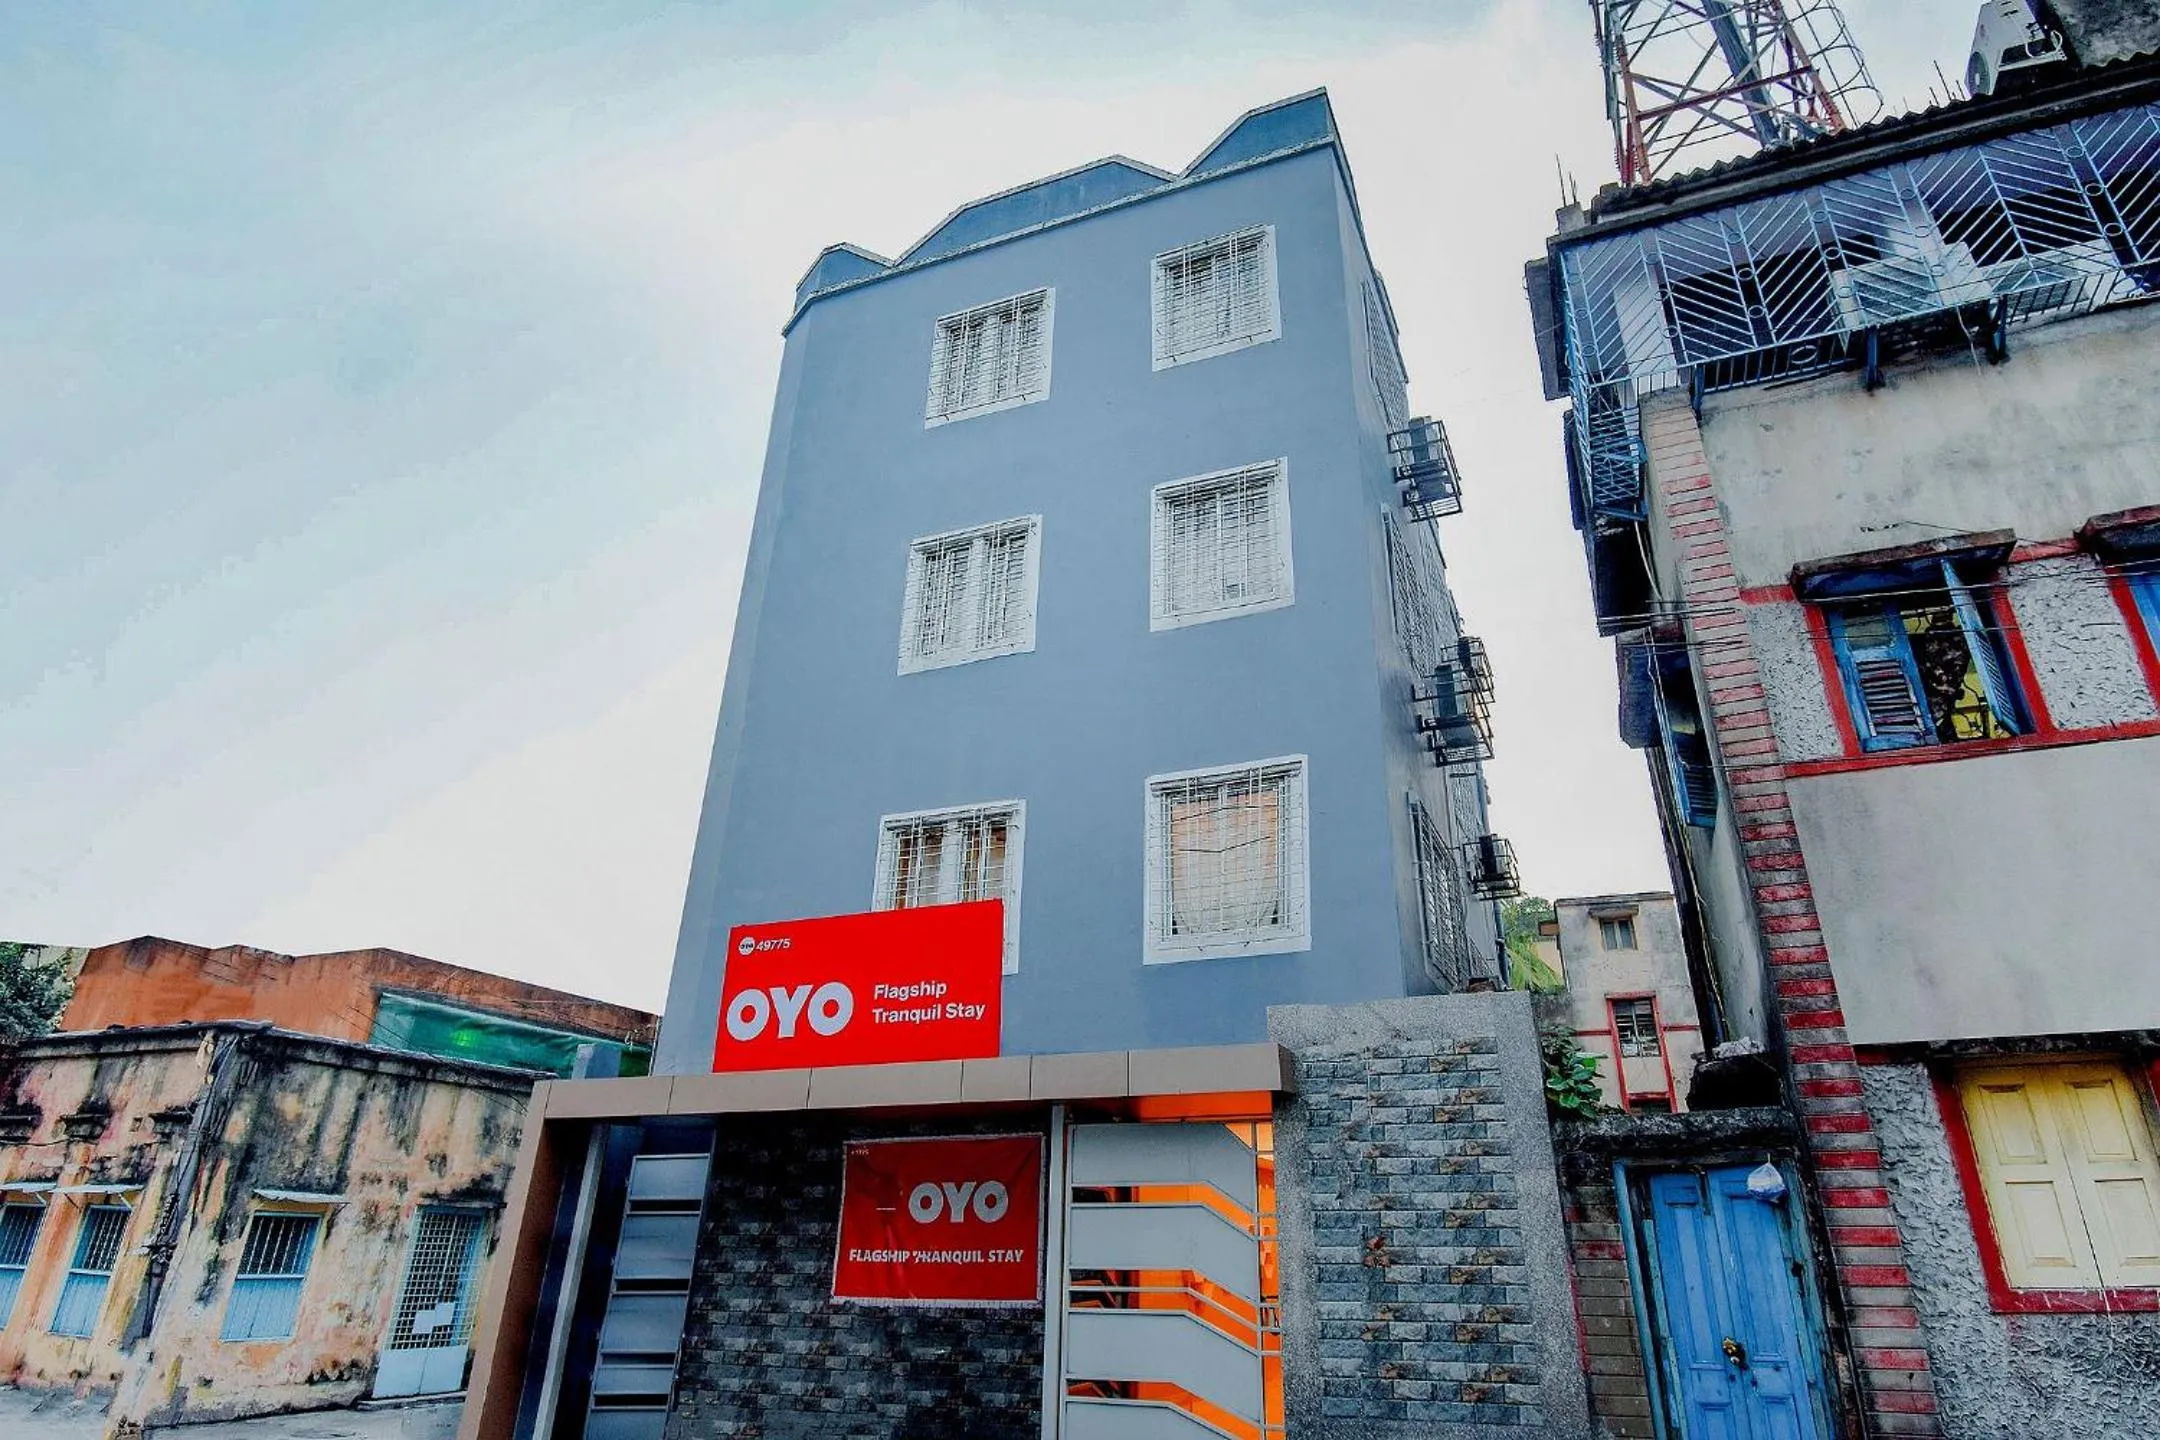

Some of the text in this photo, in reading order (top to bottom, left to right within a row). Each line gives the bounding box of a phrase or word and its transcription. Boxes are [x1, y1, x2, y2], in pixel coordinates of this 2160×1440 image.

[756, 938, 791, 951] 49775
[873, 980, 948, 1002] Flagship
[726, 981, 854, 1041] OYO
[872, 1001, 986, 1025] Tranquil Stay
[908, 1180, 1009, 1224] OYO
[849, 1248, 911, 1263] FLAGSHIP
[987, 1248, 1024, 1263] STAY
